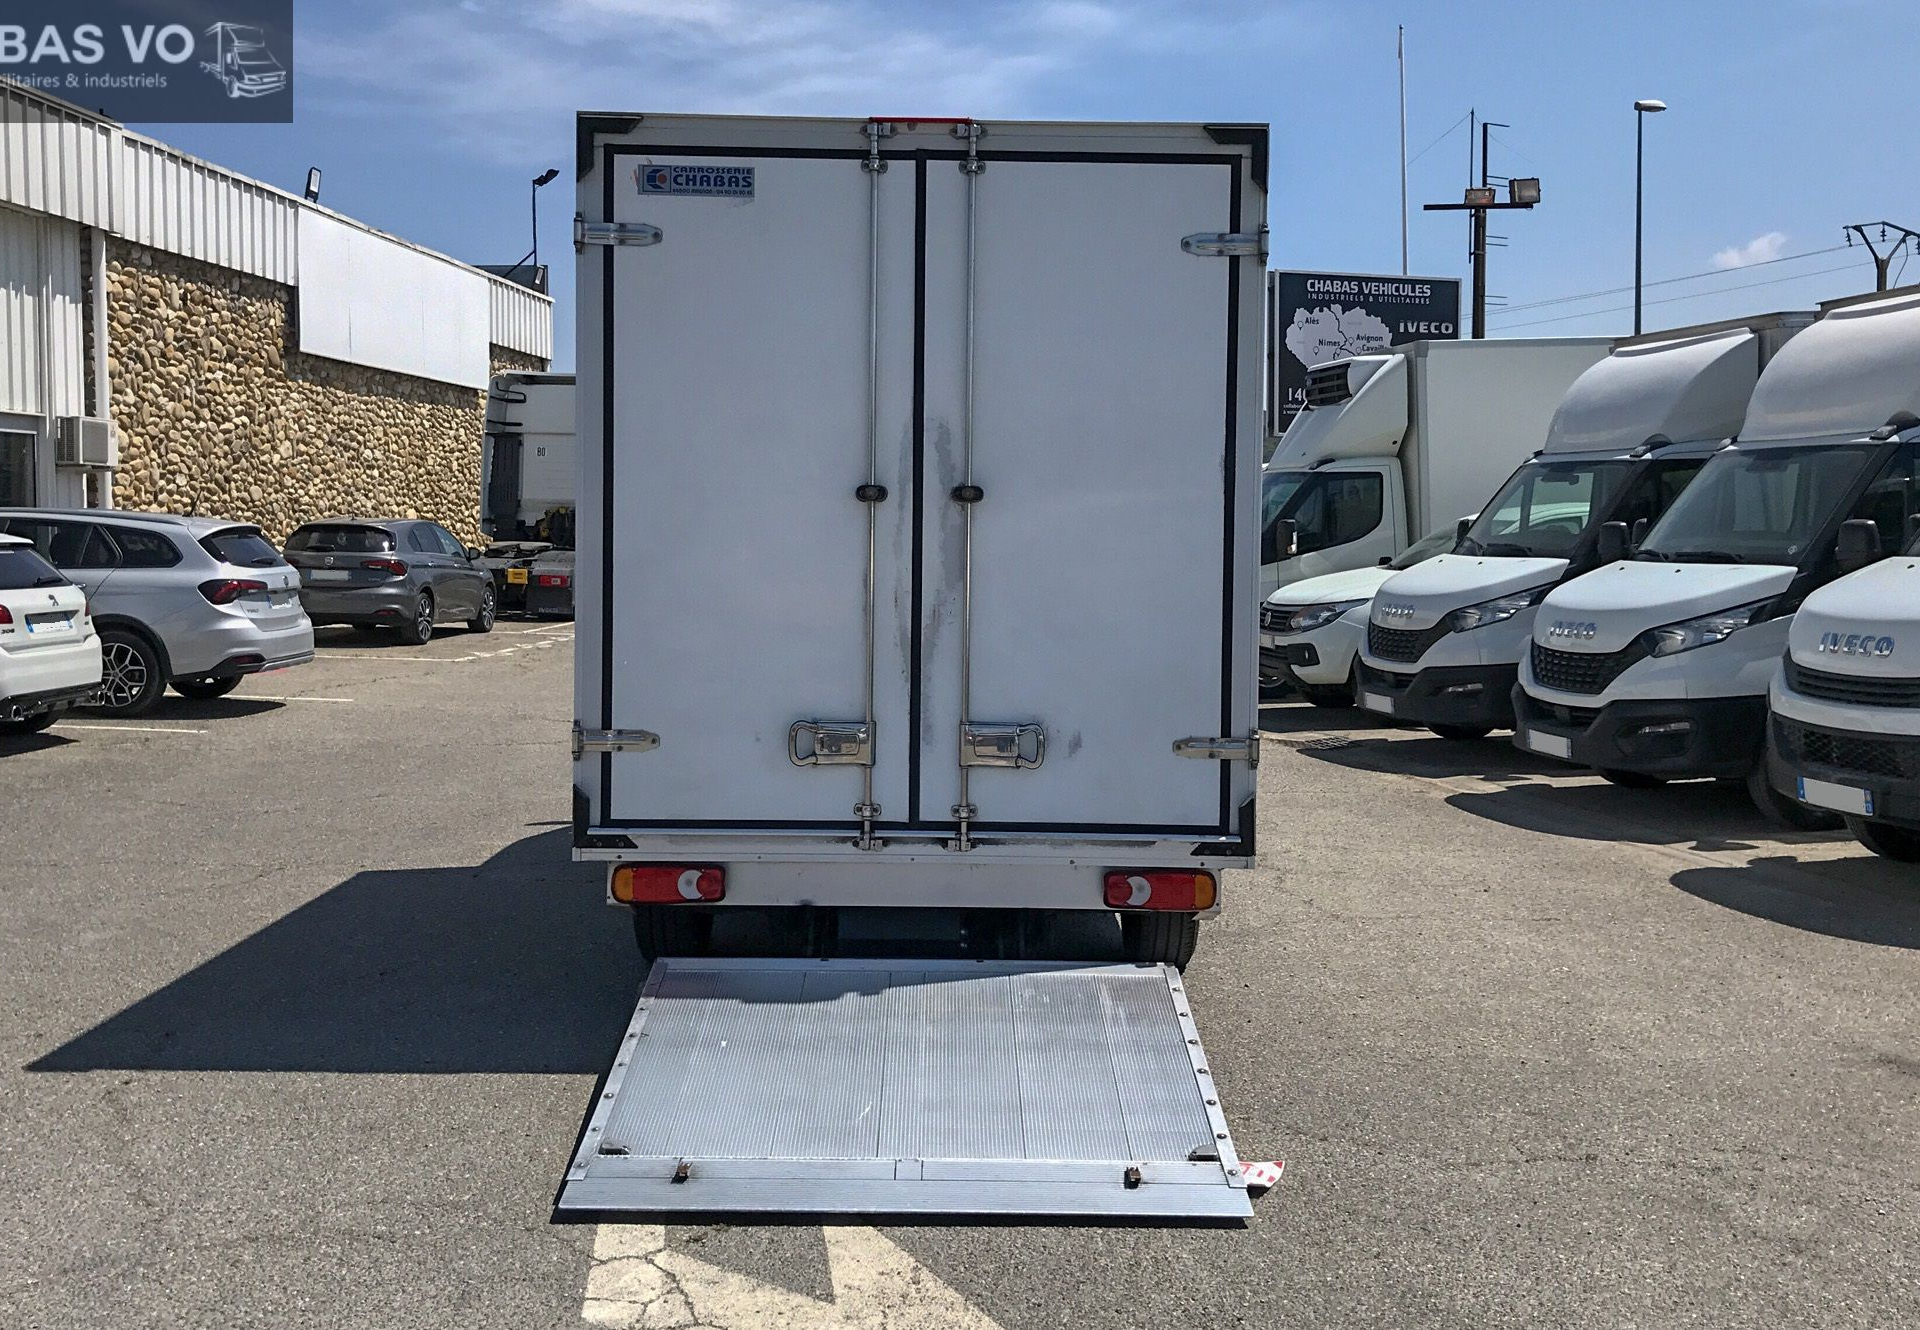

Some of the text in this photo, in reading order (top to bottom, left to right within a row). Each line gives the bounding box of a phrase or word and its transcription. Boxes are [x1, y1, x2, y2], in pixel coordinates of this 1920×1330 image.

[673, 166, 752, 175] CARROSSERIE
[673, 174, 752, 187] CHABAS
[1307, 280, 1431, 297] CHABAS VEHICULES
[1308, 293, 1364, 302] INDUSTRIELS
[1379, 296, 1430, 305] UTILITAIRES
[1399, 321, 1454, 334] IVECO
[1356, 333, 1384, 344] Avignon
[536, 446, 546, 457] 80
[1549, 620, 1597, 641] IVECO
[1818, 631, 1895, 658] IVECO
